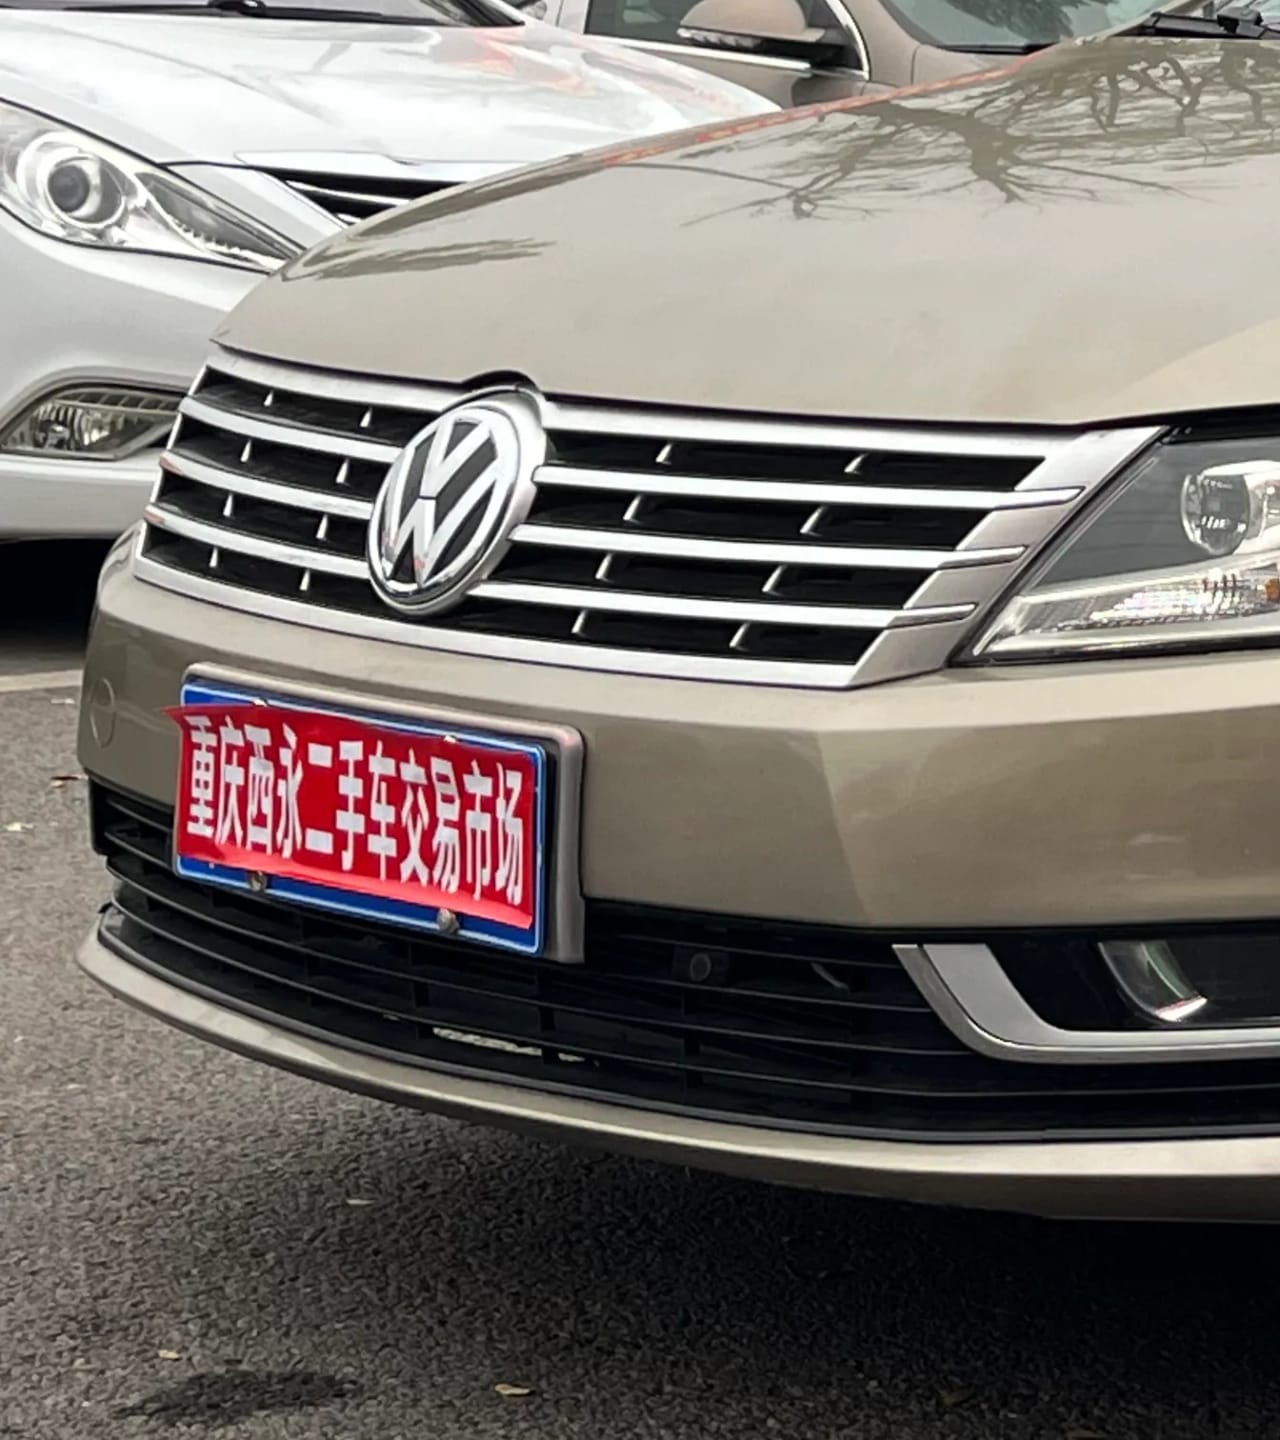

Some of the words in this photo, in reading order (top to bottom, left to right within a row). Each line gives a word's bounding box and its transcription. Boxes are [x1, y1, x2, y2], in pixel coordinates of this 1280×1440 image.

[184, 714, 525, 906] 重庆西永二手车交易市场
